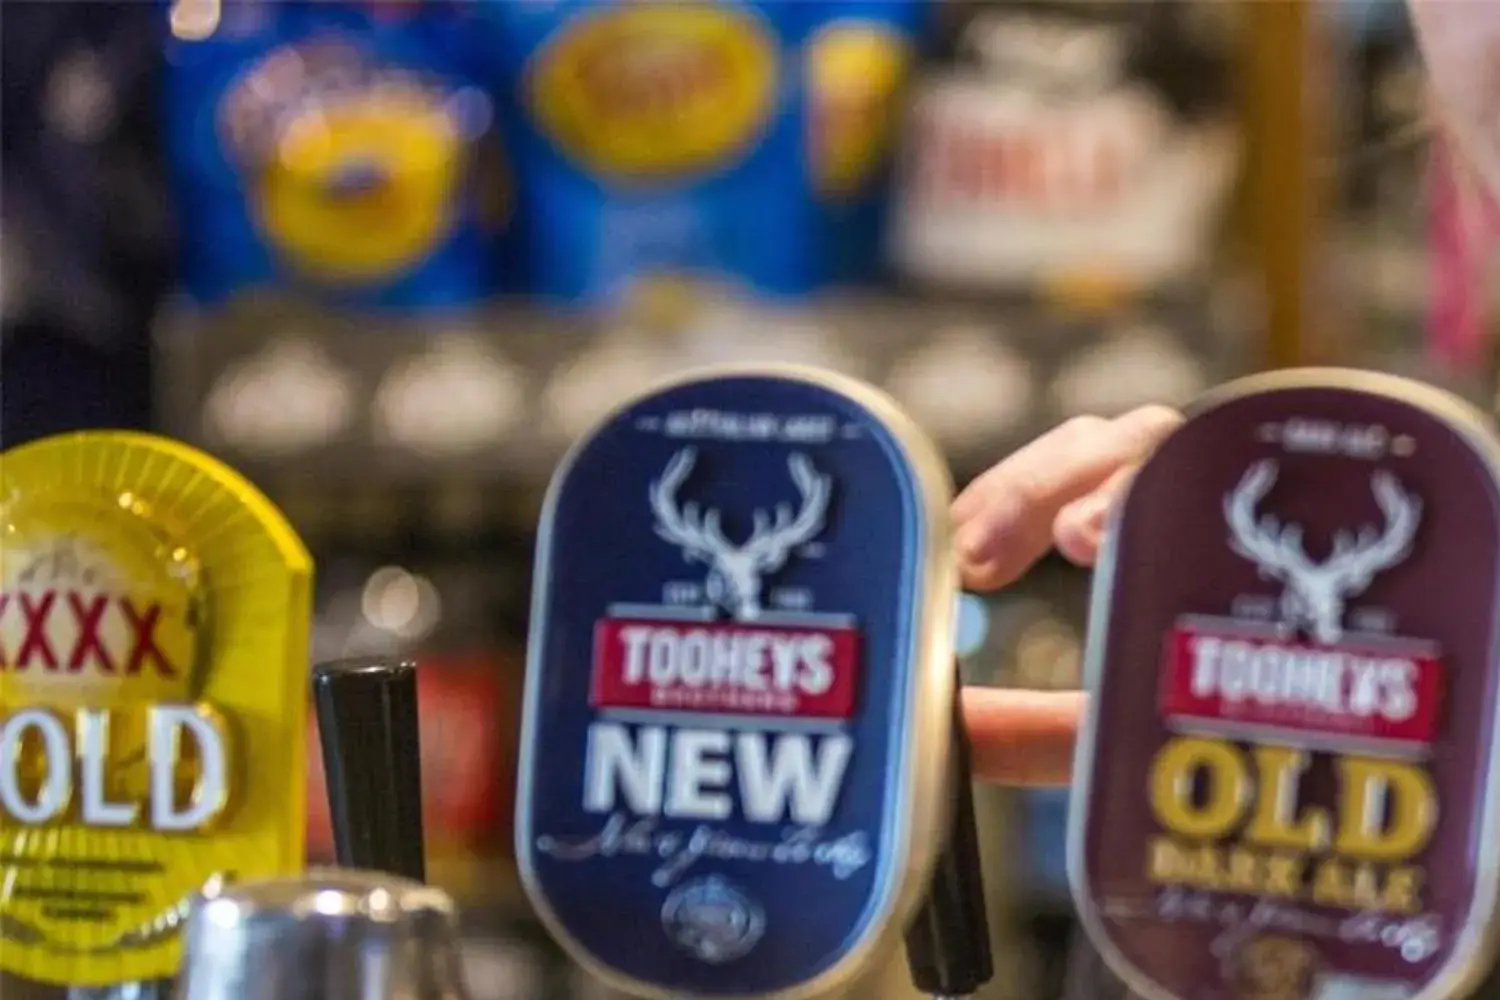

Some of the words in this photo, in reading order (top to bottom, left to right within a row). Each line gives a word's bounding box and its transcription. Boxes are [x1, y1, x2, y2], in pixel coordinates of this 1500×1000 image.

[0, 588, 178, 682] XXX
[618, 624, 835, 696] TOOHEYS
[581, 720, 853, 825] NEW
[1149, 735, 1439, 860] OLD
